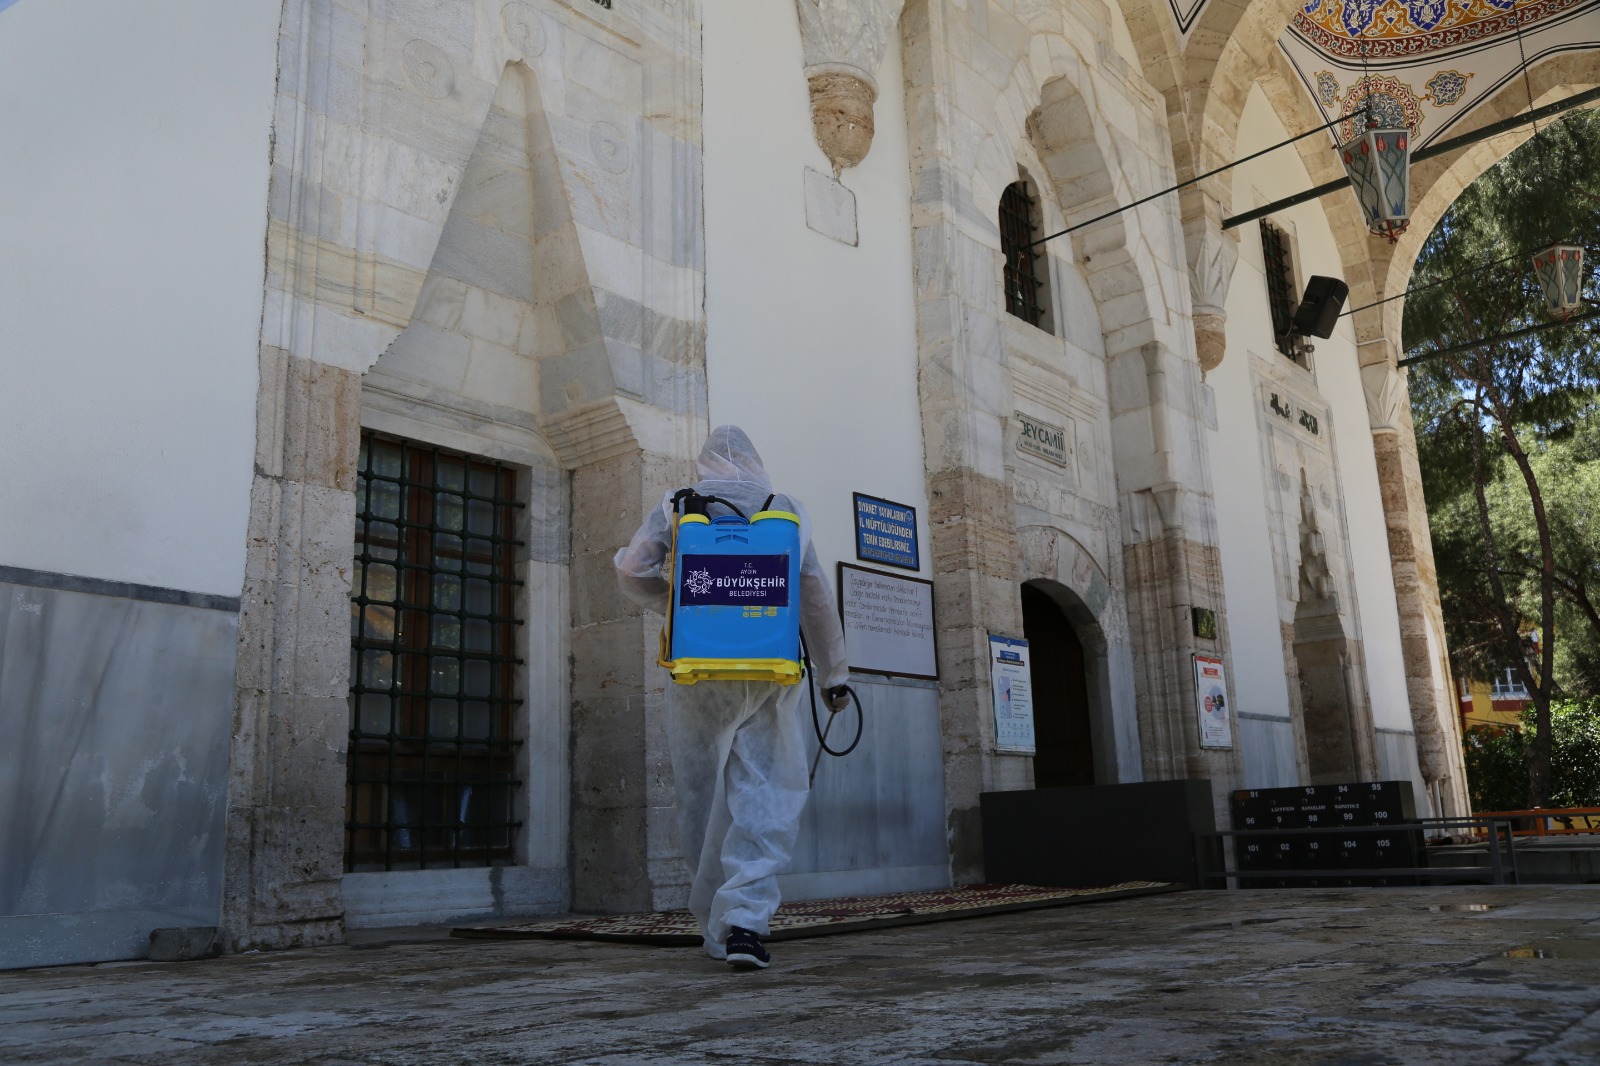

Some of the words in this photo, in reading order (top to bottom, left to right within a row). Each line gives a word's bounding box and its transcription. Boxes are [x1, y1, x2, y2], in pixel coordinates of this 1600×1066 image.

[857, 499, 878, 515] DİYANET
[858, 515, 865, 527] İL
[865, 518, 913, 539] MÜFTÜLÜĞÜNDEN
[863, 533, 878, 545] TEMİN
[716, 576, 786, 590] BÜYÜKŞEHİR
[729, 589, 767, 597] BELEDİYESİ
[1305, 787, 1316, 795] 93
[1338, 785, 1348, 793] 94
[1371, 783, 1382, 791] 95
[1374, 811, 1388, 819] 100
